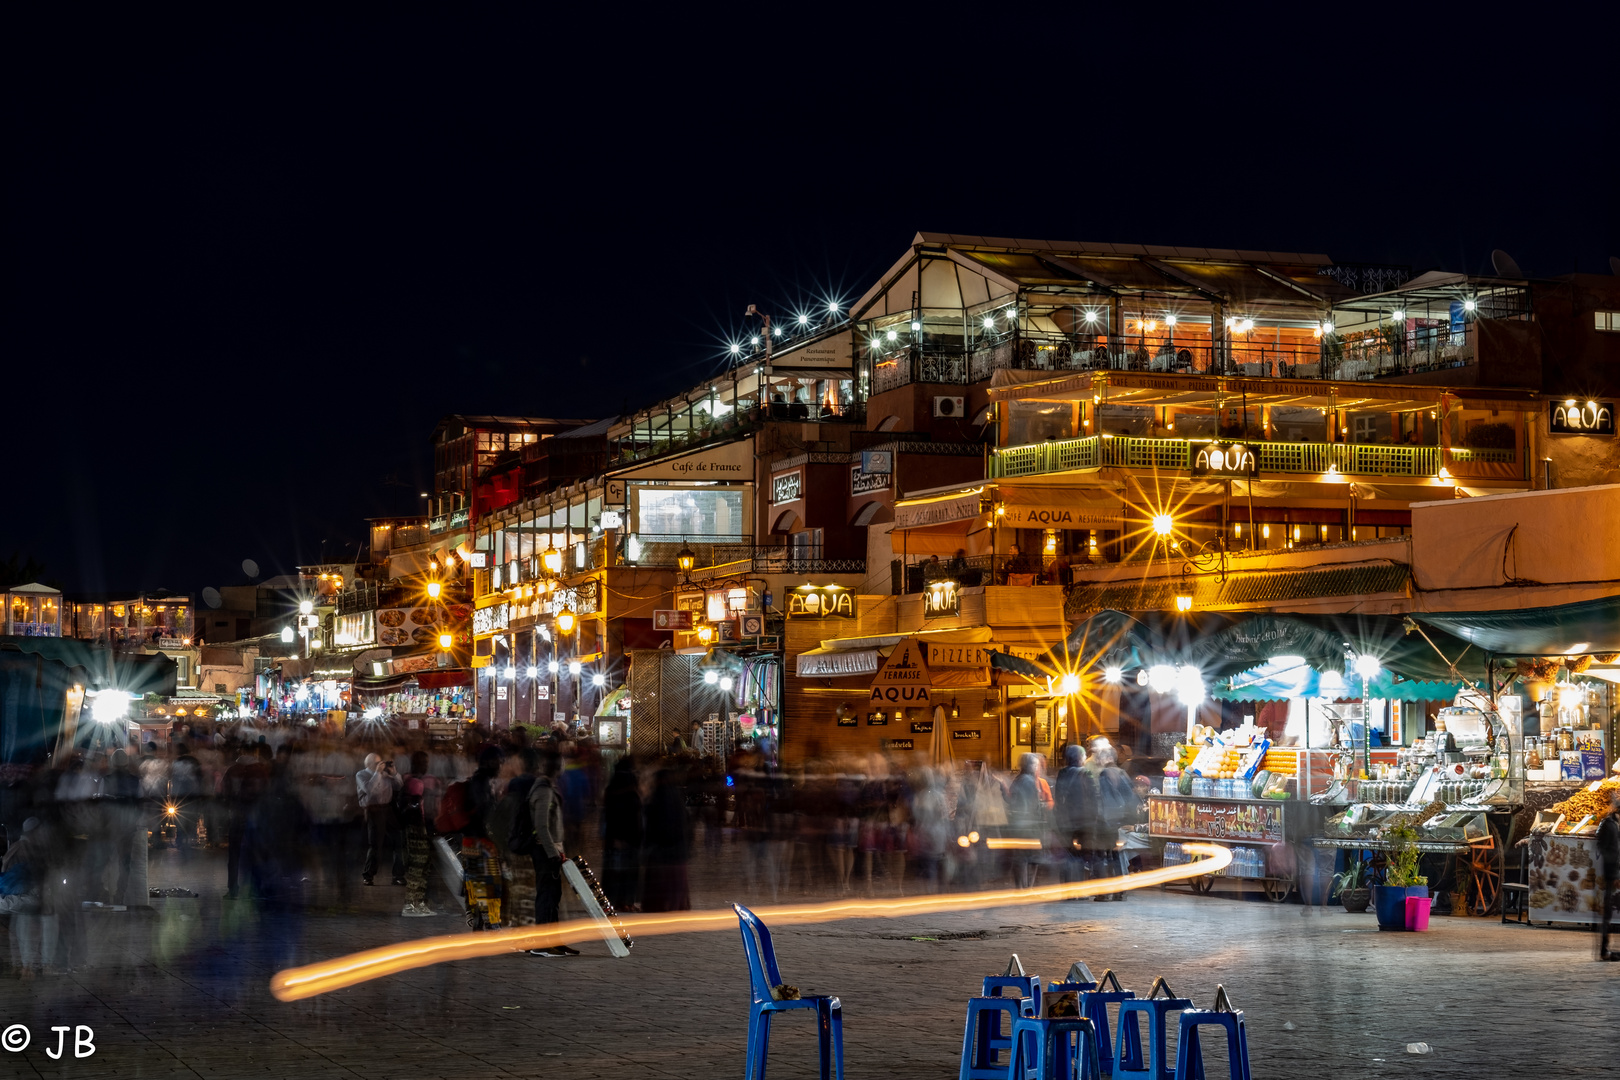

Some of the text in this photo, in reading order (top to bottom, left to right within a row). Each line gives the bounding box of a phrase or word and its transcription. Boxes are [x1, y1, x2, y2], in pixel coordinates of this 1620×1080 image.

[800, 356, 836, 364] Panoramique
[1139, 380, 1178, 389] RESTAURANT
[1188, 381, 1216, 391] PIZZERIA
[1229, 381, 1328, 395] TERRASSE PANORAMIQUE
[1552, 406, 1612, 430] AQUA
[1195, 449, 1255, 472] AQUA
[672, 461, 742, 475] Café de France
[1027, 510, 1072, 524] AQUA
[1078, 515, 1118, 524] RESTAURANT
[789, 592, 852, 614] AQUA
[925, 590, 957, 611] AQUA
[884, 670, 921, 680] TERRASSE
[870, 687, 929, 702] AQUA
